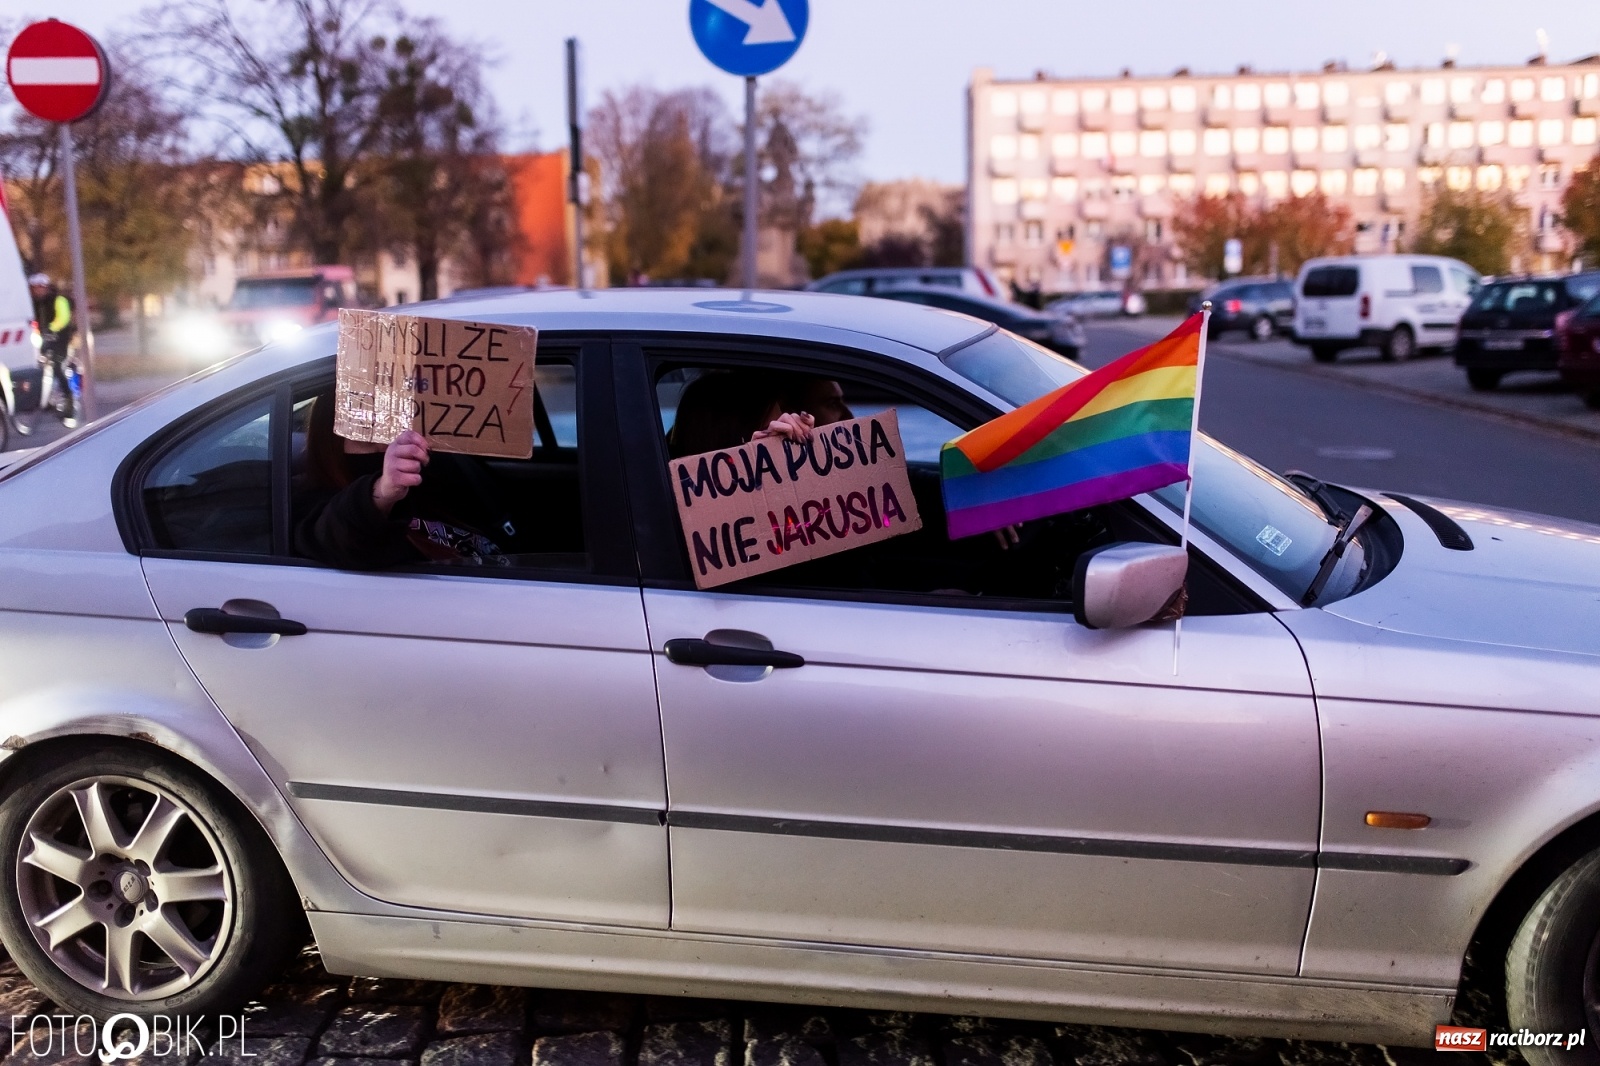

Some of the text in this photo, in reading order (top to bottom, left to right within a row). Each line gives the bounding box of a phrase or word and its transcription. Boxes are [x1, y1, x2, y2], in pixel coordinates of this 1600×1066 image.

[457, 322, 509, 362] ŻE
[402, 363, 487, 397] VITRO
[677, 418, 896, 507] MOJA PUSIA
[692, 482, 907, 576] NIE JARUSIA
